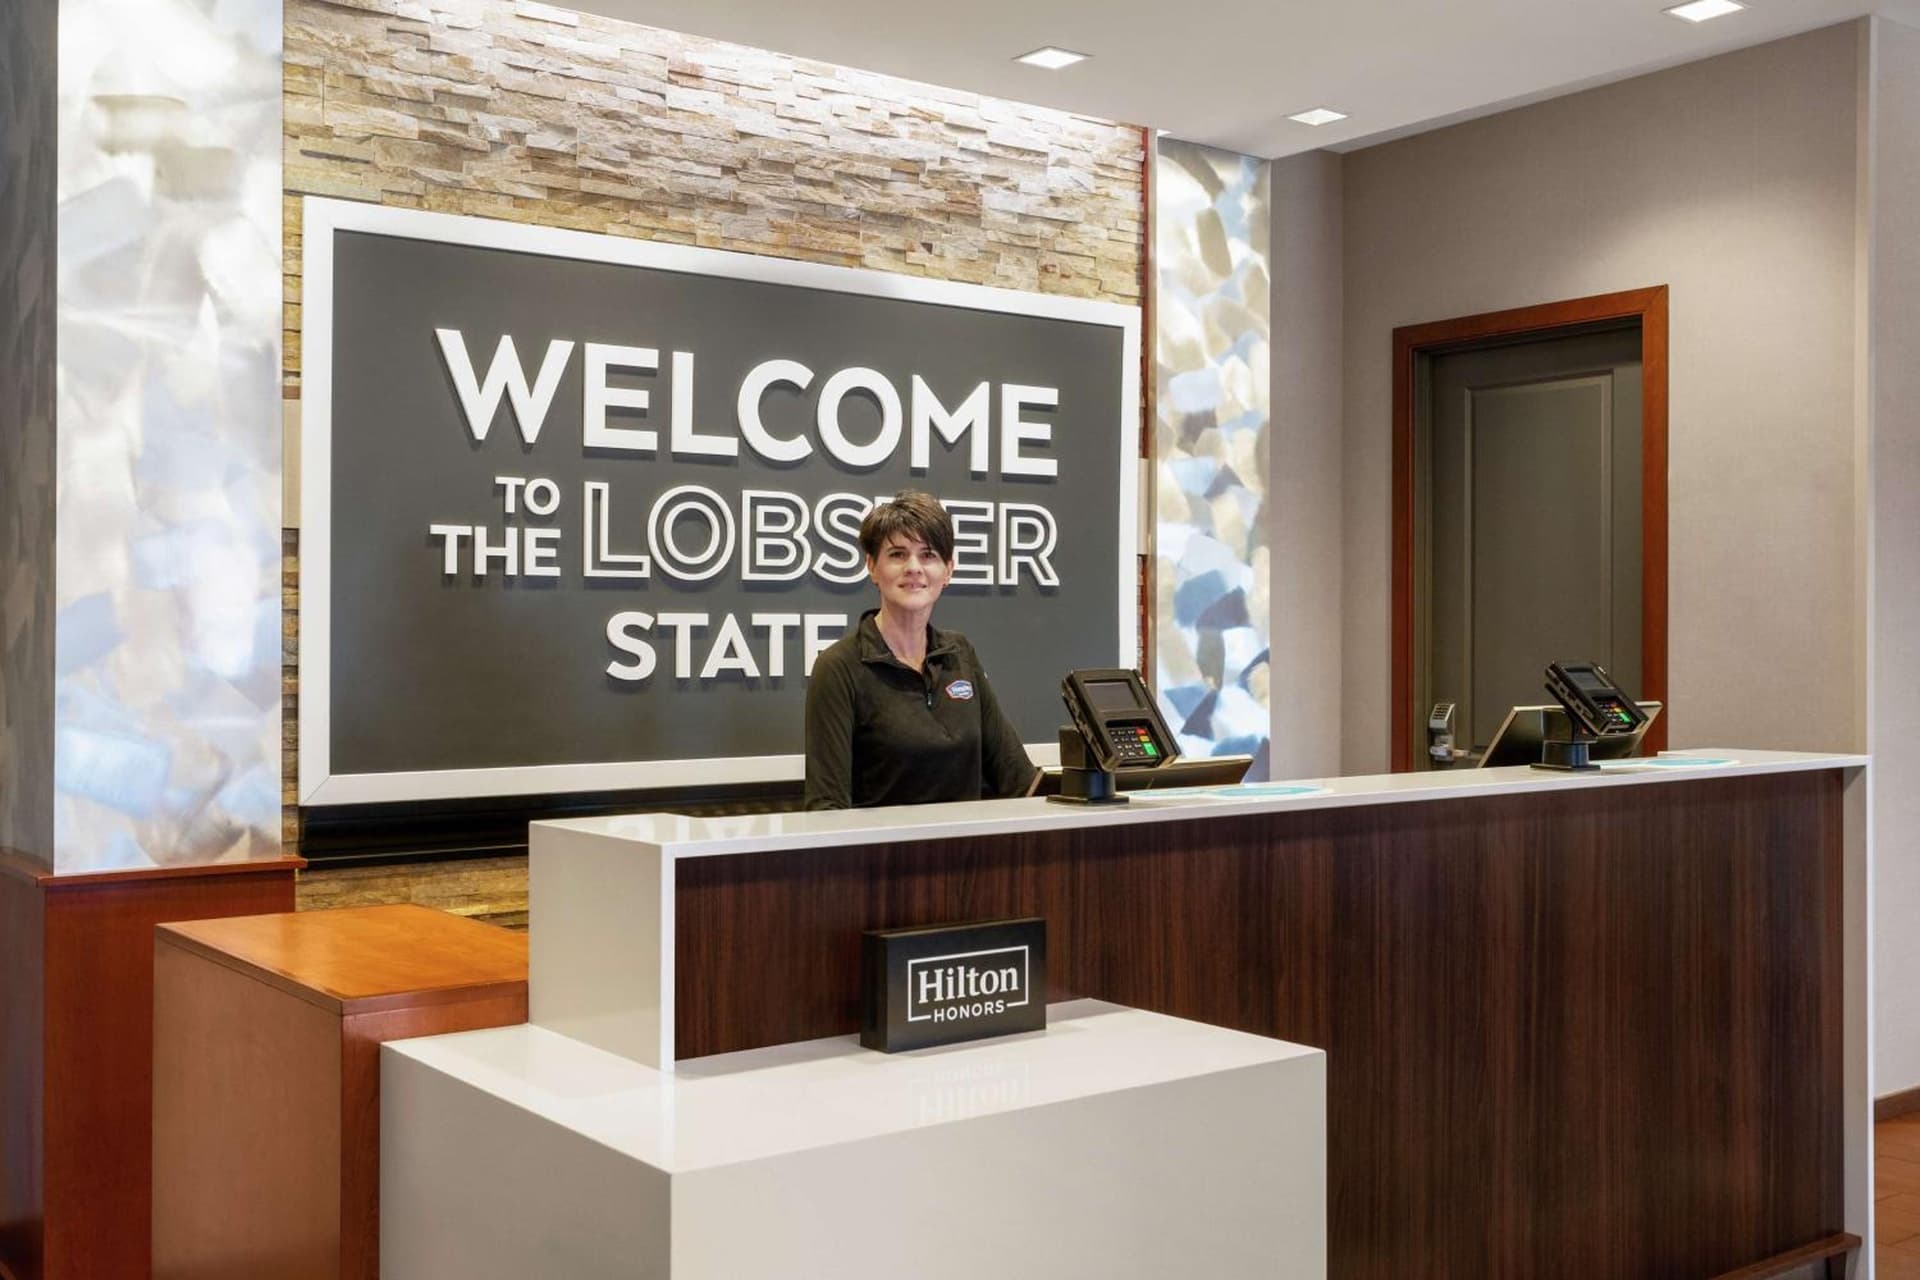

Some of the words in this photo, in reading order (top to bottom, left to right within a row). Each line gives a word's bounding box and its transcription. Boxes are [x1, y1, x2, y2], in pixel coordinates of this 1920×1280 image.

[435, 328, 1059, 476] WELCOME
[495, 476, 561, 514] TO
[430, 524, 561, 577] THE
[584, 481, 1060, 587] LOBSER
[918, 966, 1018, 1004] Hilton
[934, 1000, 1005, 1023] HONORS
